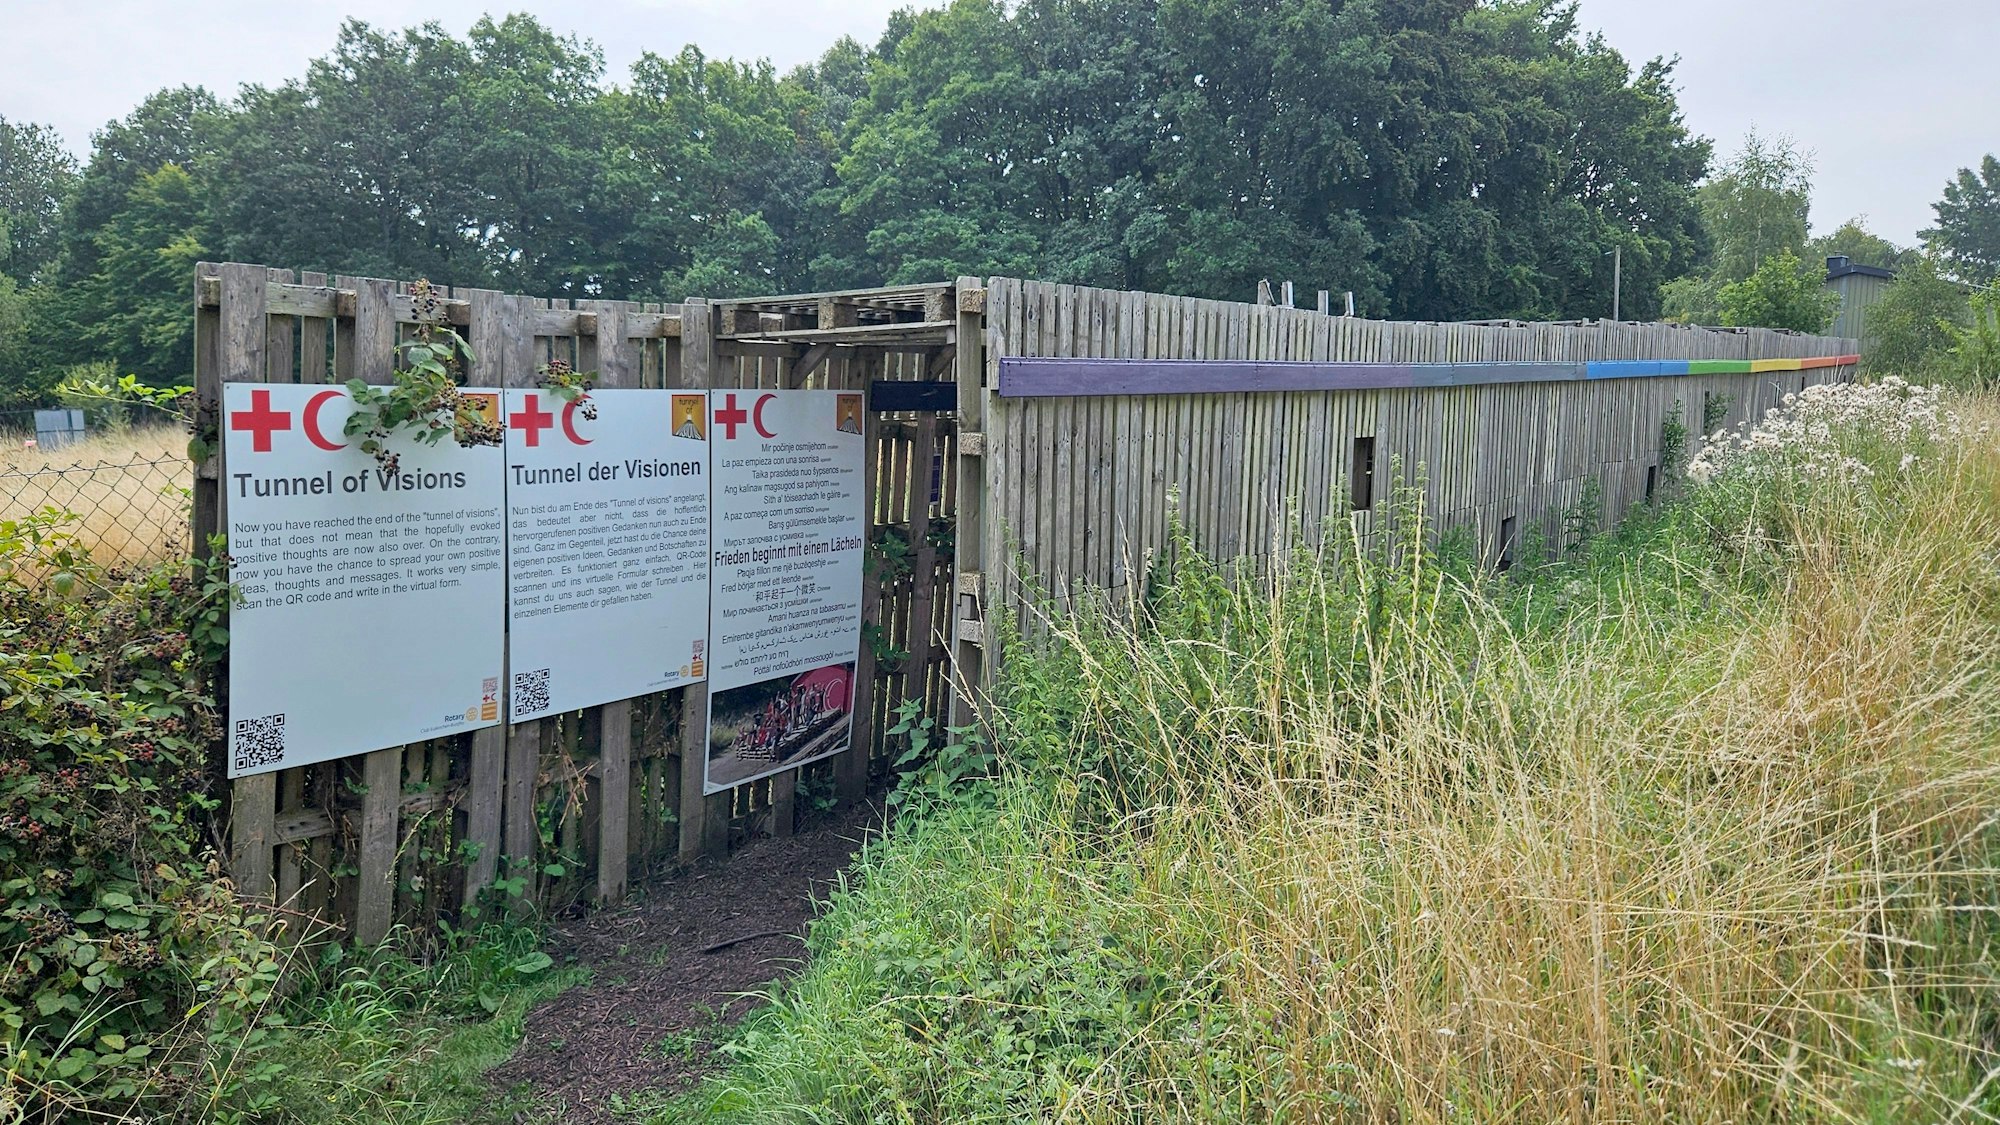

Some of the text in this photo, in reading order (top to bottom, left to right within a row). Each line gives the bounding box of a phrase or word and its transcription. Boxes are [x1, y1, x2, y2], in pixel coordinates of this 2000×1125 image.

[233, 468, 466, 497] Tunnel of Visions
[511, 459, 700, 486] Tunnel der Visionen
[512, 507, 529, 516] Nun
[530, 505, 546, 515] bist
[546, 504, 557, 513] du
[573, 502, 593, 511] Ende
[594, 501, 608, 510] des
[637, 498, 645, 506] of
[512, 508, 667, 529] das bedeutet aber dass die
[235, 522, 260, 533] Now
[262, 522, 282, 534] you
[285, 519, 311, 530] have
[313, 516, 354, 528] reached
[356, 515, 372, 526] the
[374, 514, 393, 525] end
[394, 513, 404, 524] of
[406, 512, 421, 523] the
[455, 510, 464, 520] of
[235, 521, 500, 549] but that does not mean that the hopefully evoked
[577, 525, 610, 538] positiven
[611, 521, 648, 532] Gedanken
[662, 518, 680, 528] auch
[689, 516, 707, 525] Ende
[236, 551, 277, 567] positive
[282, 547, 328, 561] thoughts
[332, 547, 349, 557] are
[353, 546, 374, 555] now
[378, 542, 399, 553] also
[429, 539, 443, 549] On
[446, 538, 461, 548] the
[533, 543, 555, 552] Ganz
[556, 541, 566, 550] im
[623, 533, 639, 544] hast
[640, 533, 649, 542] du
[650, 532, 661, 541] die
[662, 530, 688, 540] Chance
[688, 528, 706, 537] deine
[714, 537, 862, 567] Frieden beginnt mit einem Lächeln
[236, 548, 500, 580] now you have the chance to spread your own positive
[513, 543, 658, 569] eigenen positiven Gedanken und
[561, 565, 571, 575] Es
[577, 560, 617, 573] funktioniert
[622, 559, 640, 570] ganz
[676, 550, 707, 561] QR-Code
[236, 583, 269, 595] deas,
[274, 578, 320, 592] thoughts
[325, 575, 344, 587] and
[406, 568, 413, 579] It
[416, 566, 444, 578] works
[448, 566, 467, 576] very
[513, 562, 707, 594] scannen und ins Formular Hier
[514, 594, 540, 606] kannst
[543, 593, 554, 602] du
[558, 592, 572, 600] uns
[575, 587, 594, 598] auch
[625, 582, 638, 591] wie
[640, 580, 652, 589] der
[655, 576, 678, 587] Tunnel
[680, 574, 694, 584] und
[696, 572, 706, 582] die
[236, 600, 262, 611] scan
[265, 596, 282, 608] the
[285, 593, 303, 605] QR
[306, 591, 332, 603] code
[334, 588, 353, 600] and
[355, 586, 379, 598] write
[381, 585, 390, 595] in
[392, 583, 408, 594] the
[409, 580, 437, 592] virtual
[514, 599, 600, 620] einzelnen Elemente dir
[444, 714, 465, 722] Rotary
